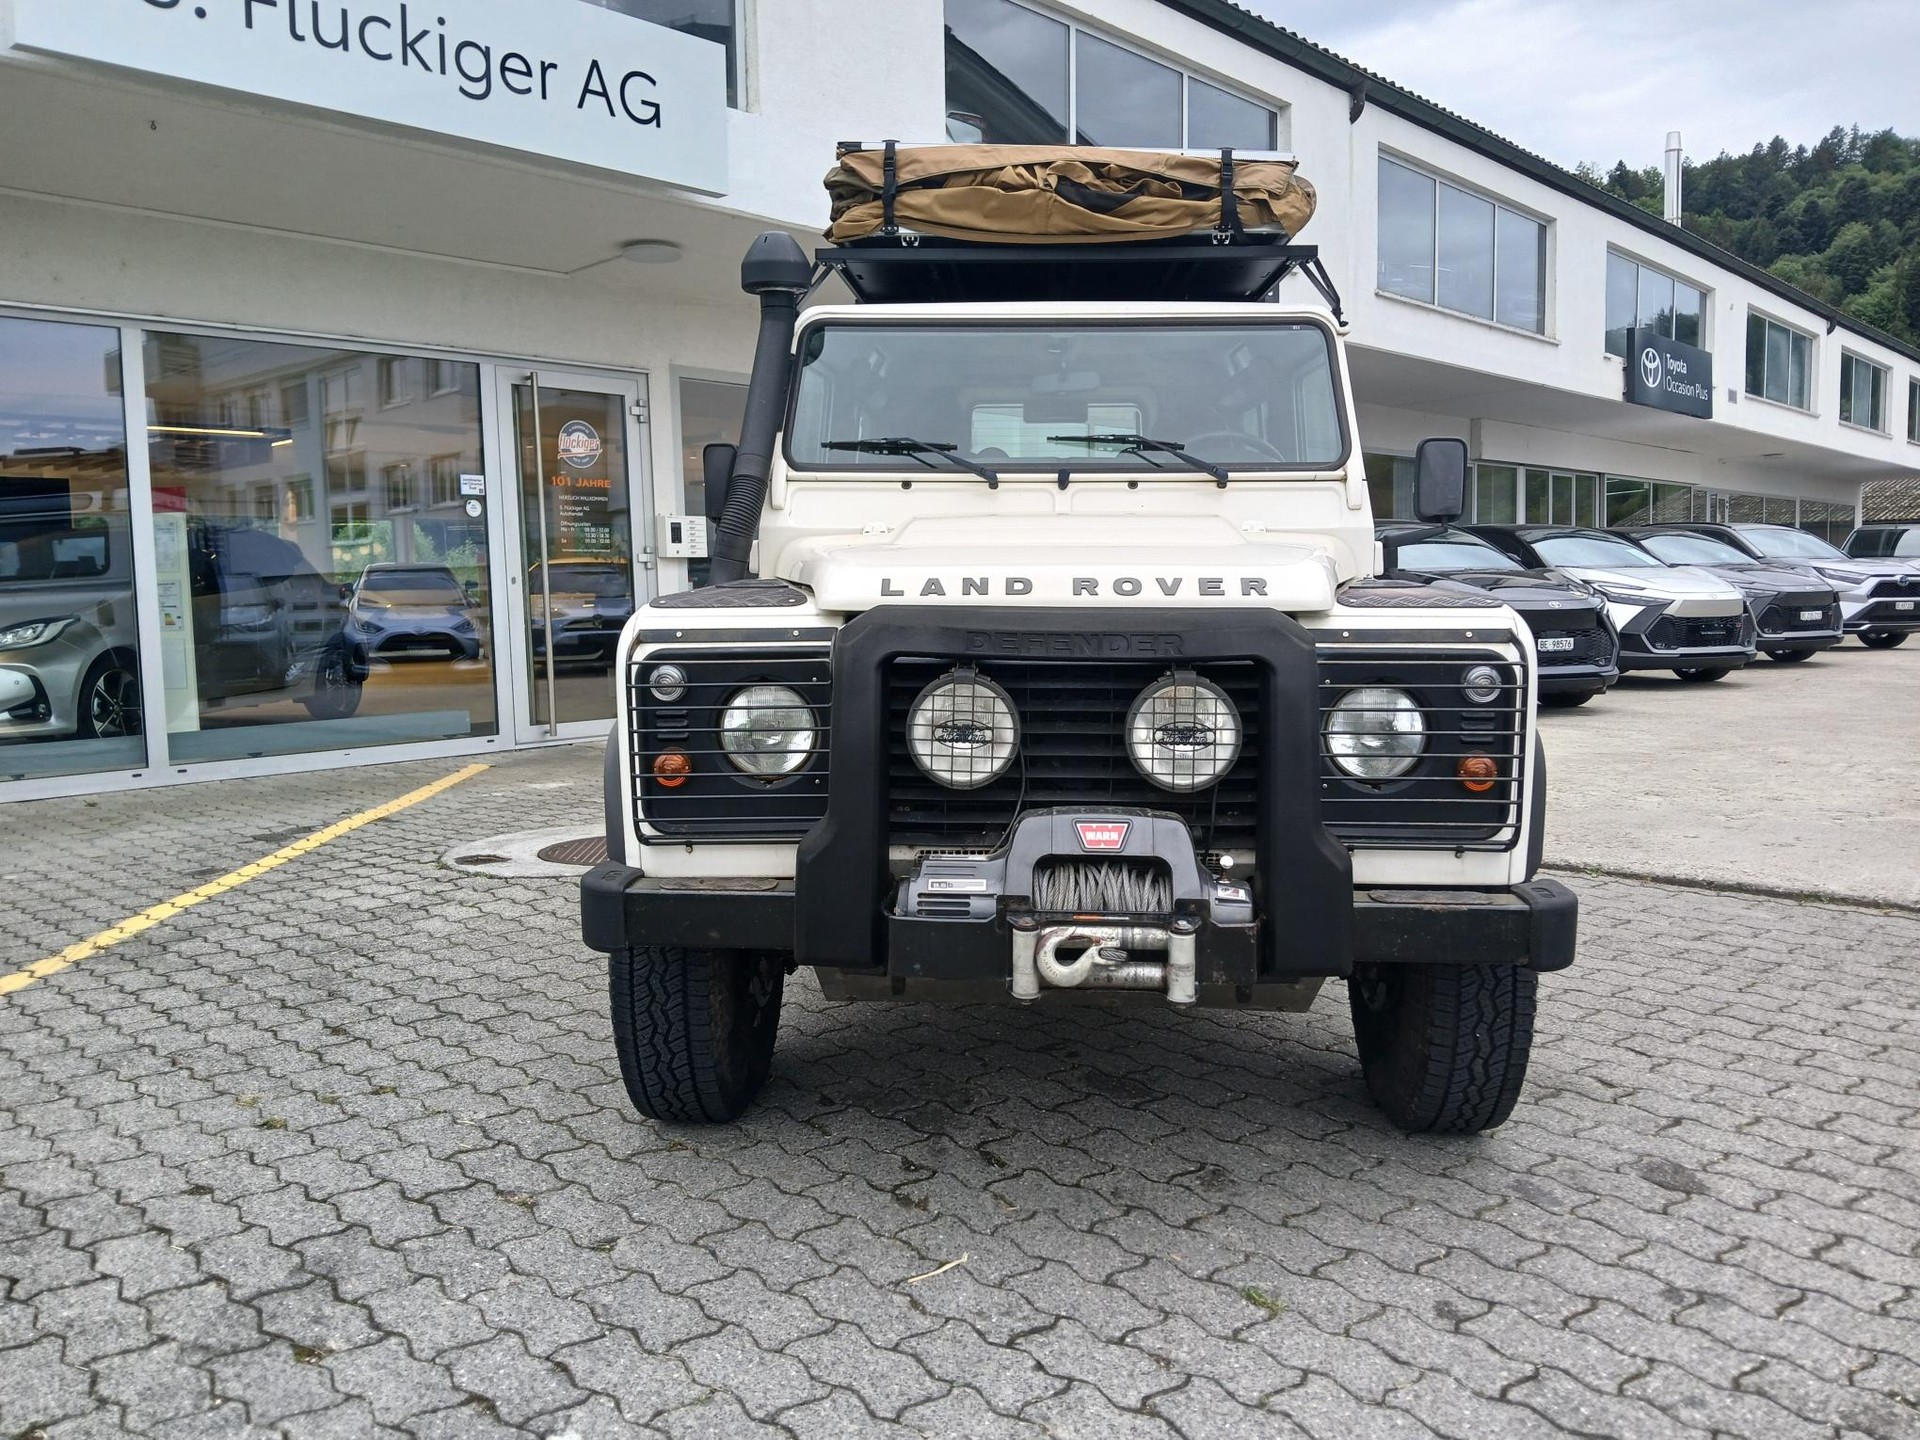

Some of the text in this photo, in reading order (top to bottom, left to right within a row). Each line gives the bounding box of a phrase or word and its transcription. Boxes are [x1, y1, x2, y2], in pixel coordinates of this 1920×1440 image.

[576, 58, 662, 128] AG
[1666, 353, 1688, 375] Toyota
[1666, 375, 1709, 400] Occasion Plus
[551, 476, 613, 488] 101 JAHRE
[880, 577, 1268, 596] LAND ROVER
[966, 630, 1184, 656] DEFENDER
[1540, 640, 1572, 649] BE 98576
[1085, 831, 1119, 841] WARN
